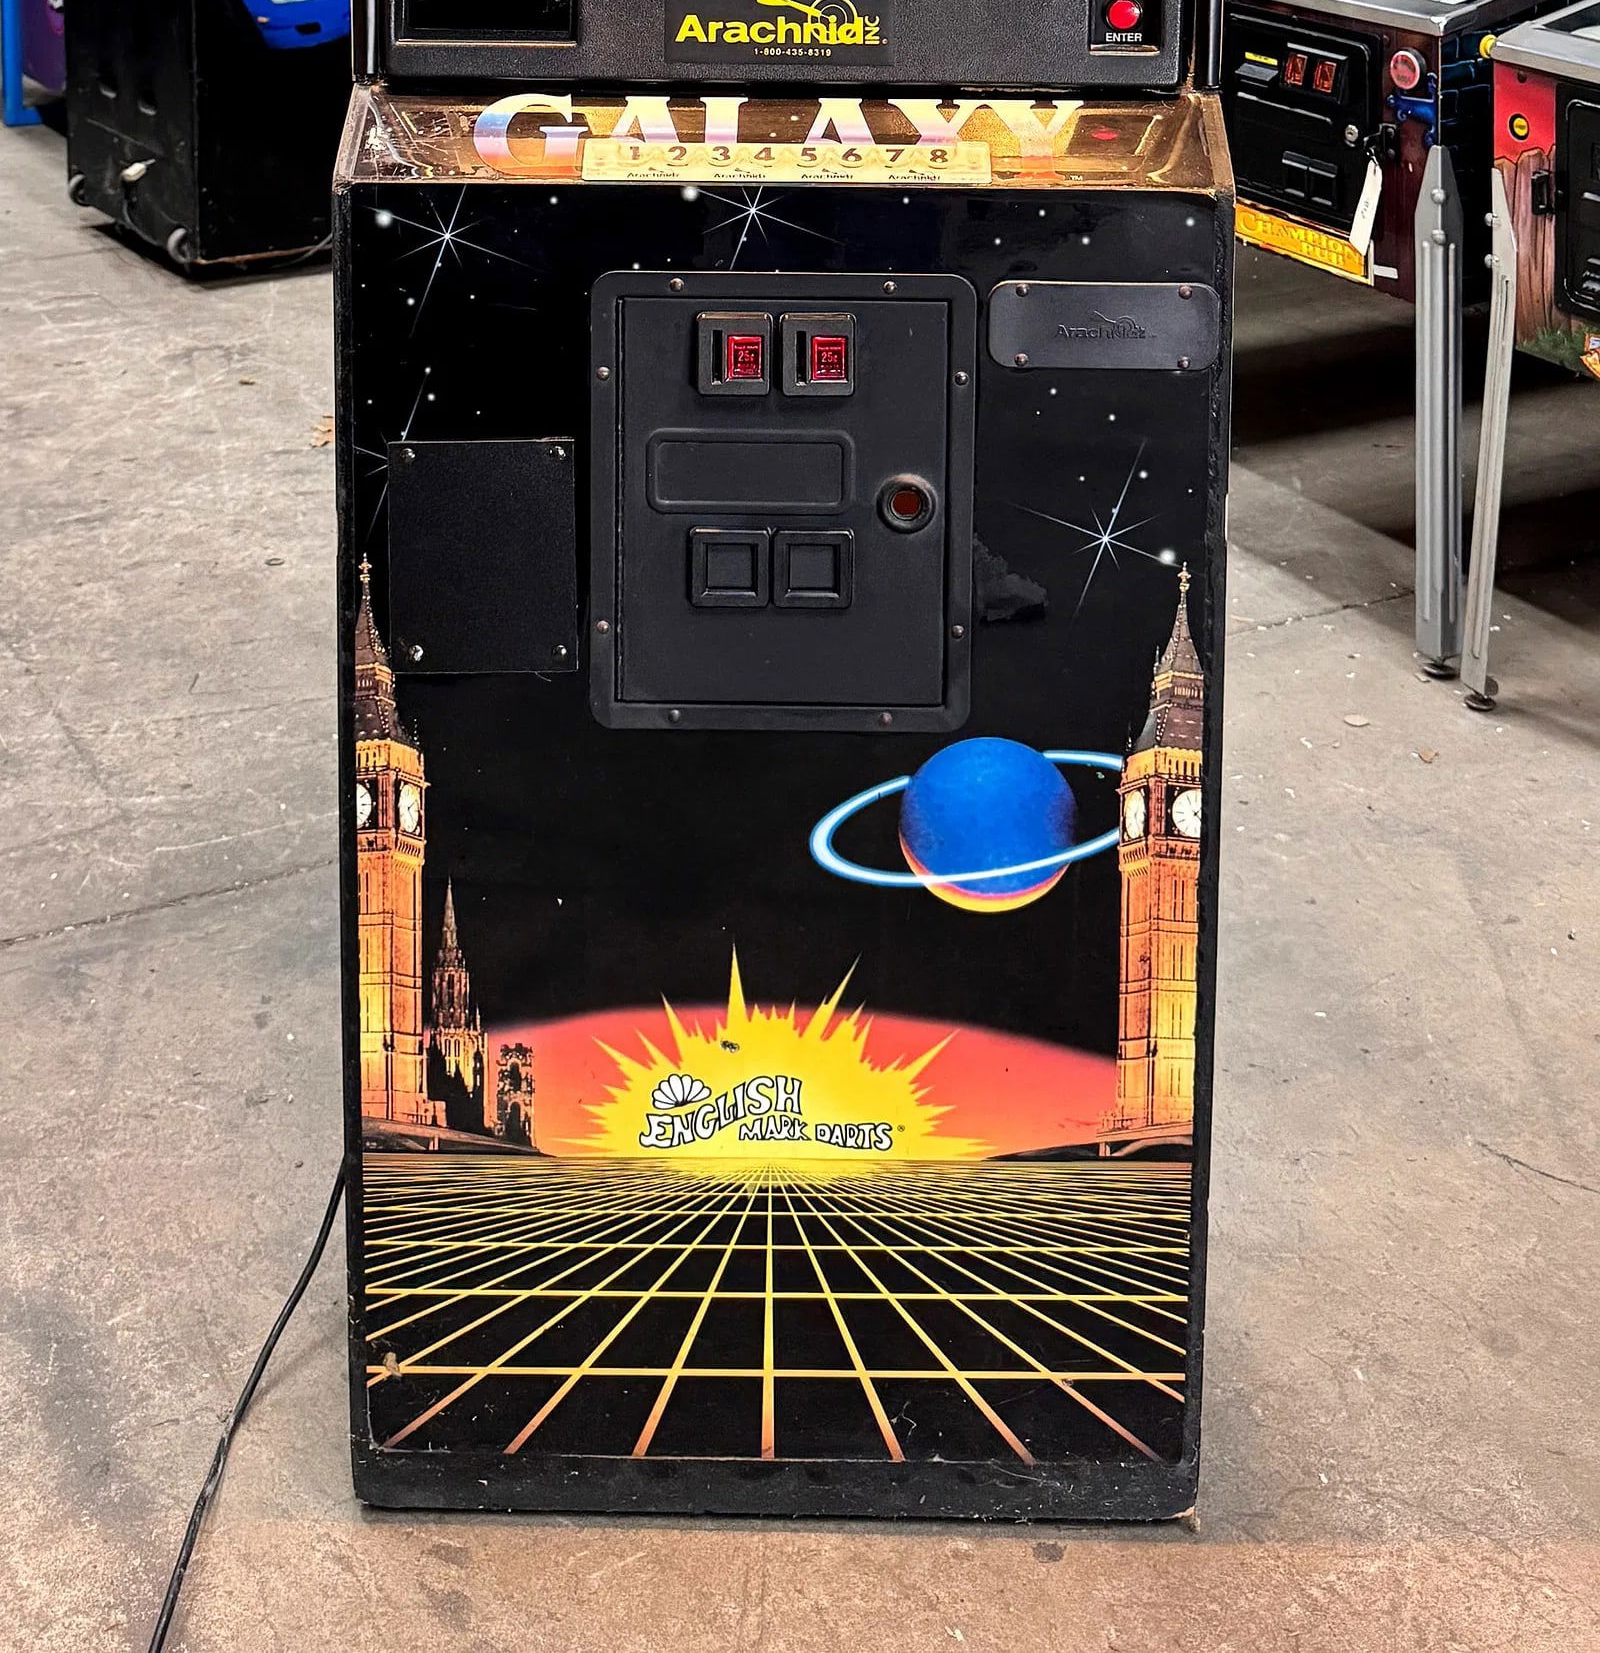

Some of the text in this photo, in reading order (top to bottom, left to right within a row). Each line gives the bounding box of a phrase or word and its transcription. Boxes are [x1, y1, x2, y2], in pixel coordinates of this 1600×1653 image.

[675, 14, 880, 45] Arachnid INC
[1106, 33, 1142, 42] ENTER
[754, 48, 832, 57] 1-800-435-8319
[473, 93, 1084, 181] GALAXY
[629, 146, 641, 161] 1
[668, 146, 688, 161] 2
[711, 146, 732, 162] 3
[753, 147, 776, 162] 4
[800, 147, 818, 162] 5
[841, 148, 863, 163] 6
[885, 148, 905, 163] 7
[929, 149, 949, 164] 8
[1238, 211, 1364, 266] CHAMPION
[1300, 242, 1346, 267] PUB
[639, 1075, 803, 1148] ENGLISH
[739, 1114, 893, 1151] MARK DARTS
